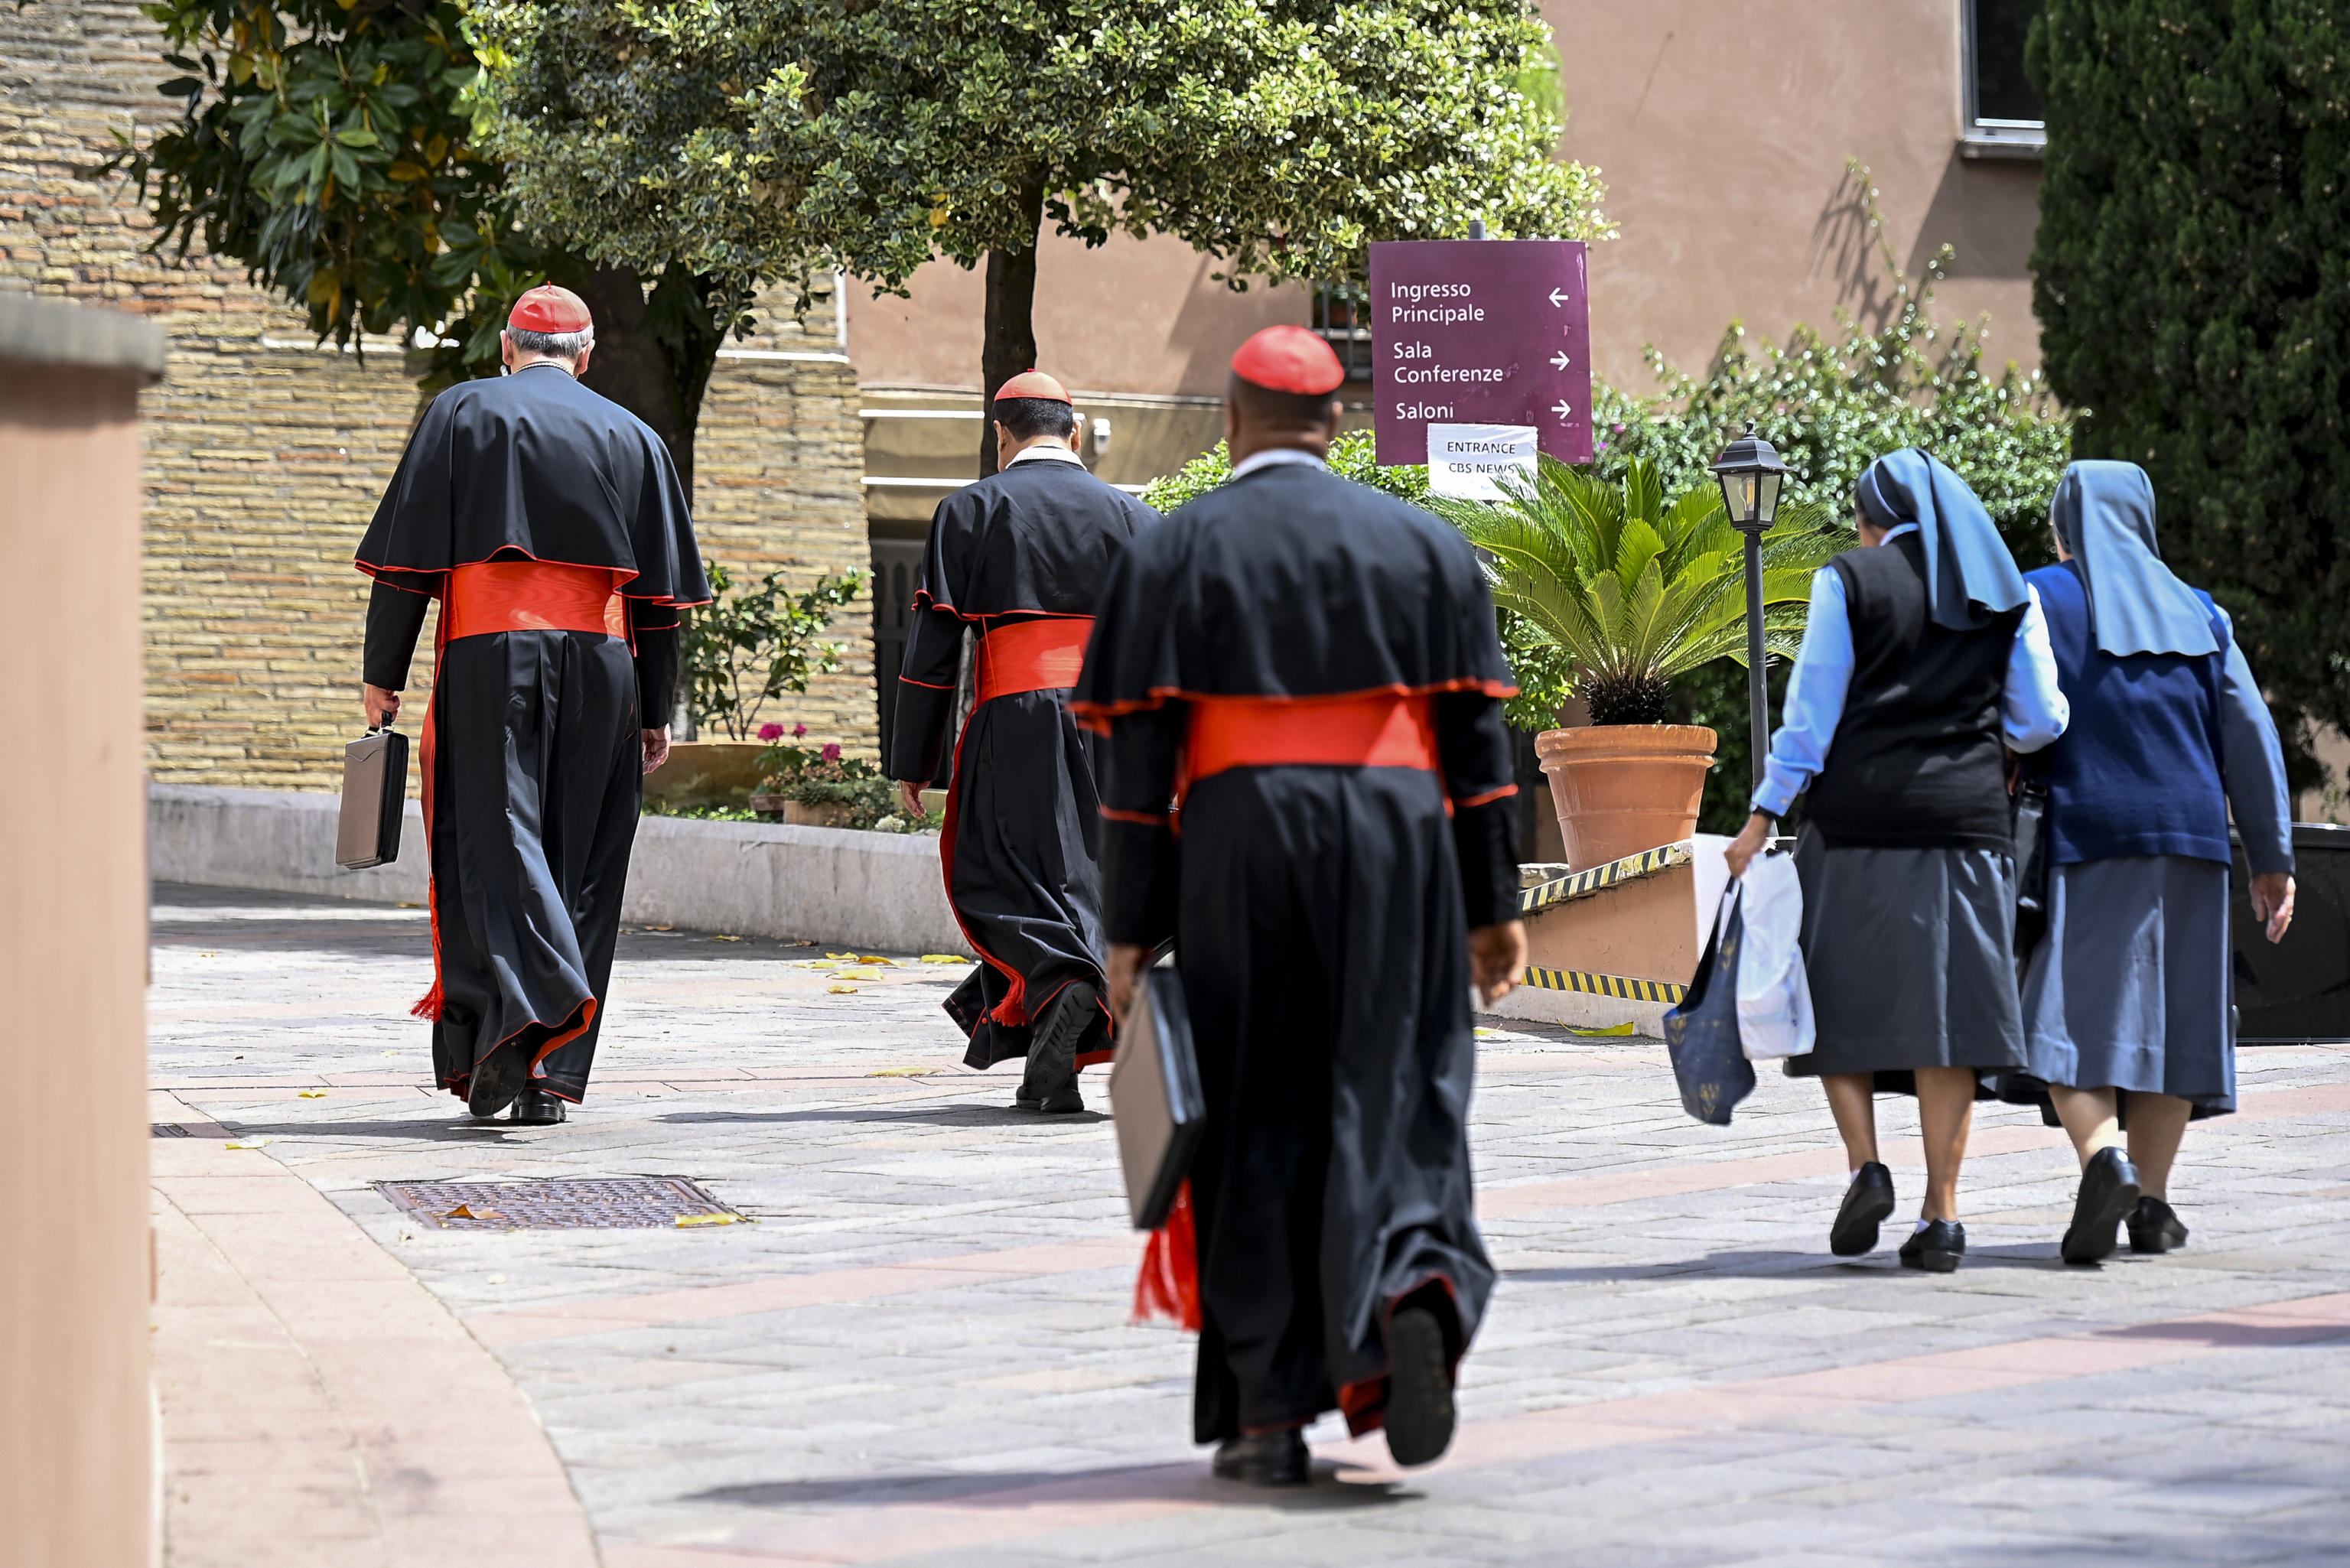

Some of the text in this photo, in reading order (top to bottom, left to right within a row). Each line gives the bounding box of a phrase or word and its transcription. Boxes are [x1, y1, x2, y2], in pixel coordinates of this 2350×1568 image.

[1391, 281, 1471, 302] Ingresso
[1392, 304, 1485, 326] Principale
[1394, 340, 1432, 359] Sala
[1395, 365, 1503, 383] Conferenze
[1396, 401, 1453, 420] Saloni
[1447, 441, 1515, 454] ENTRANCE
[1449, 463, 1515, 474] CBS NEWS
